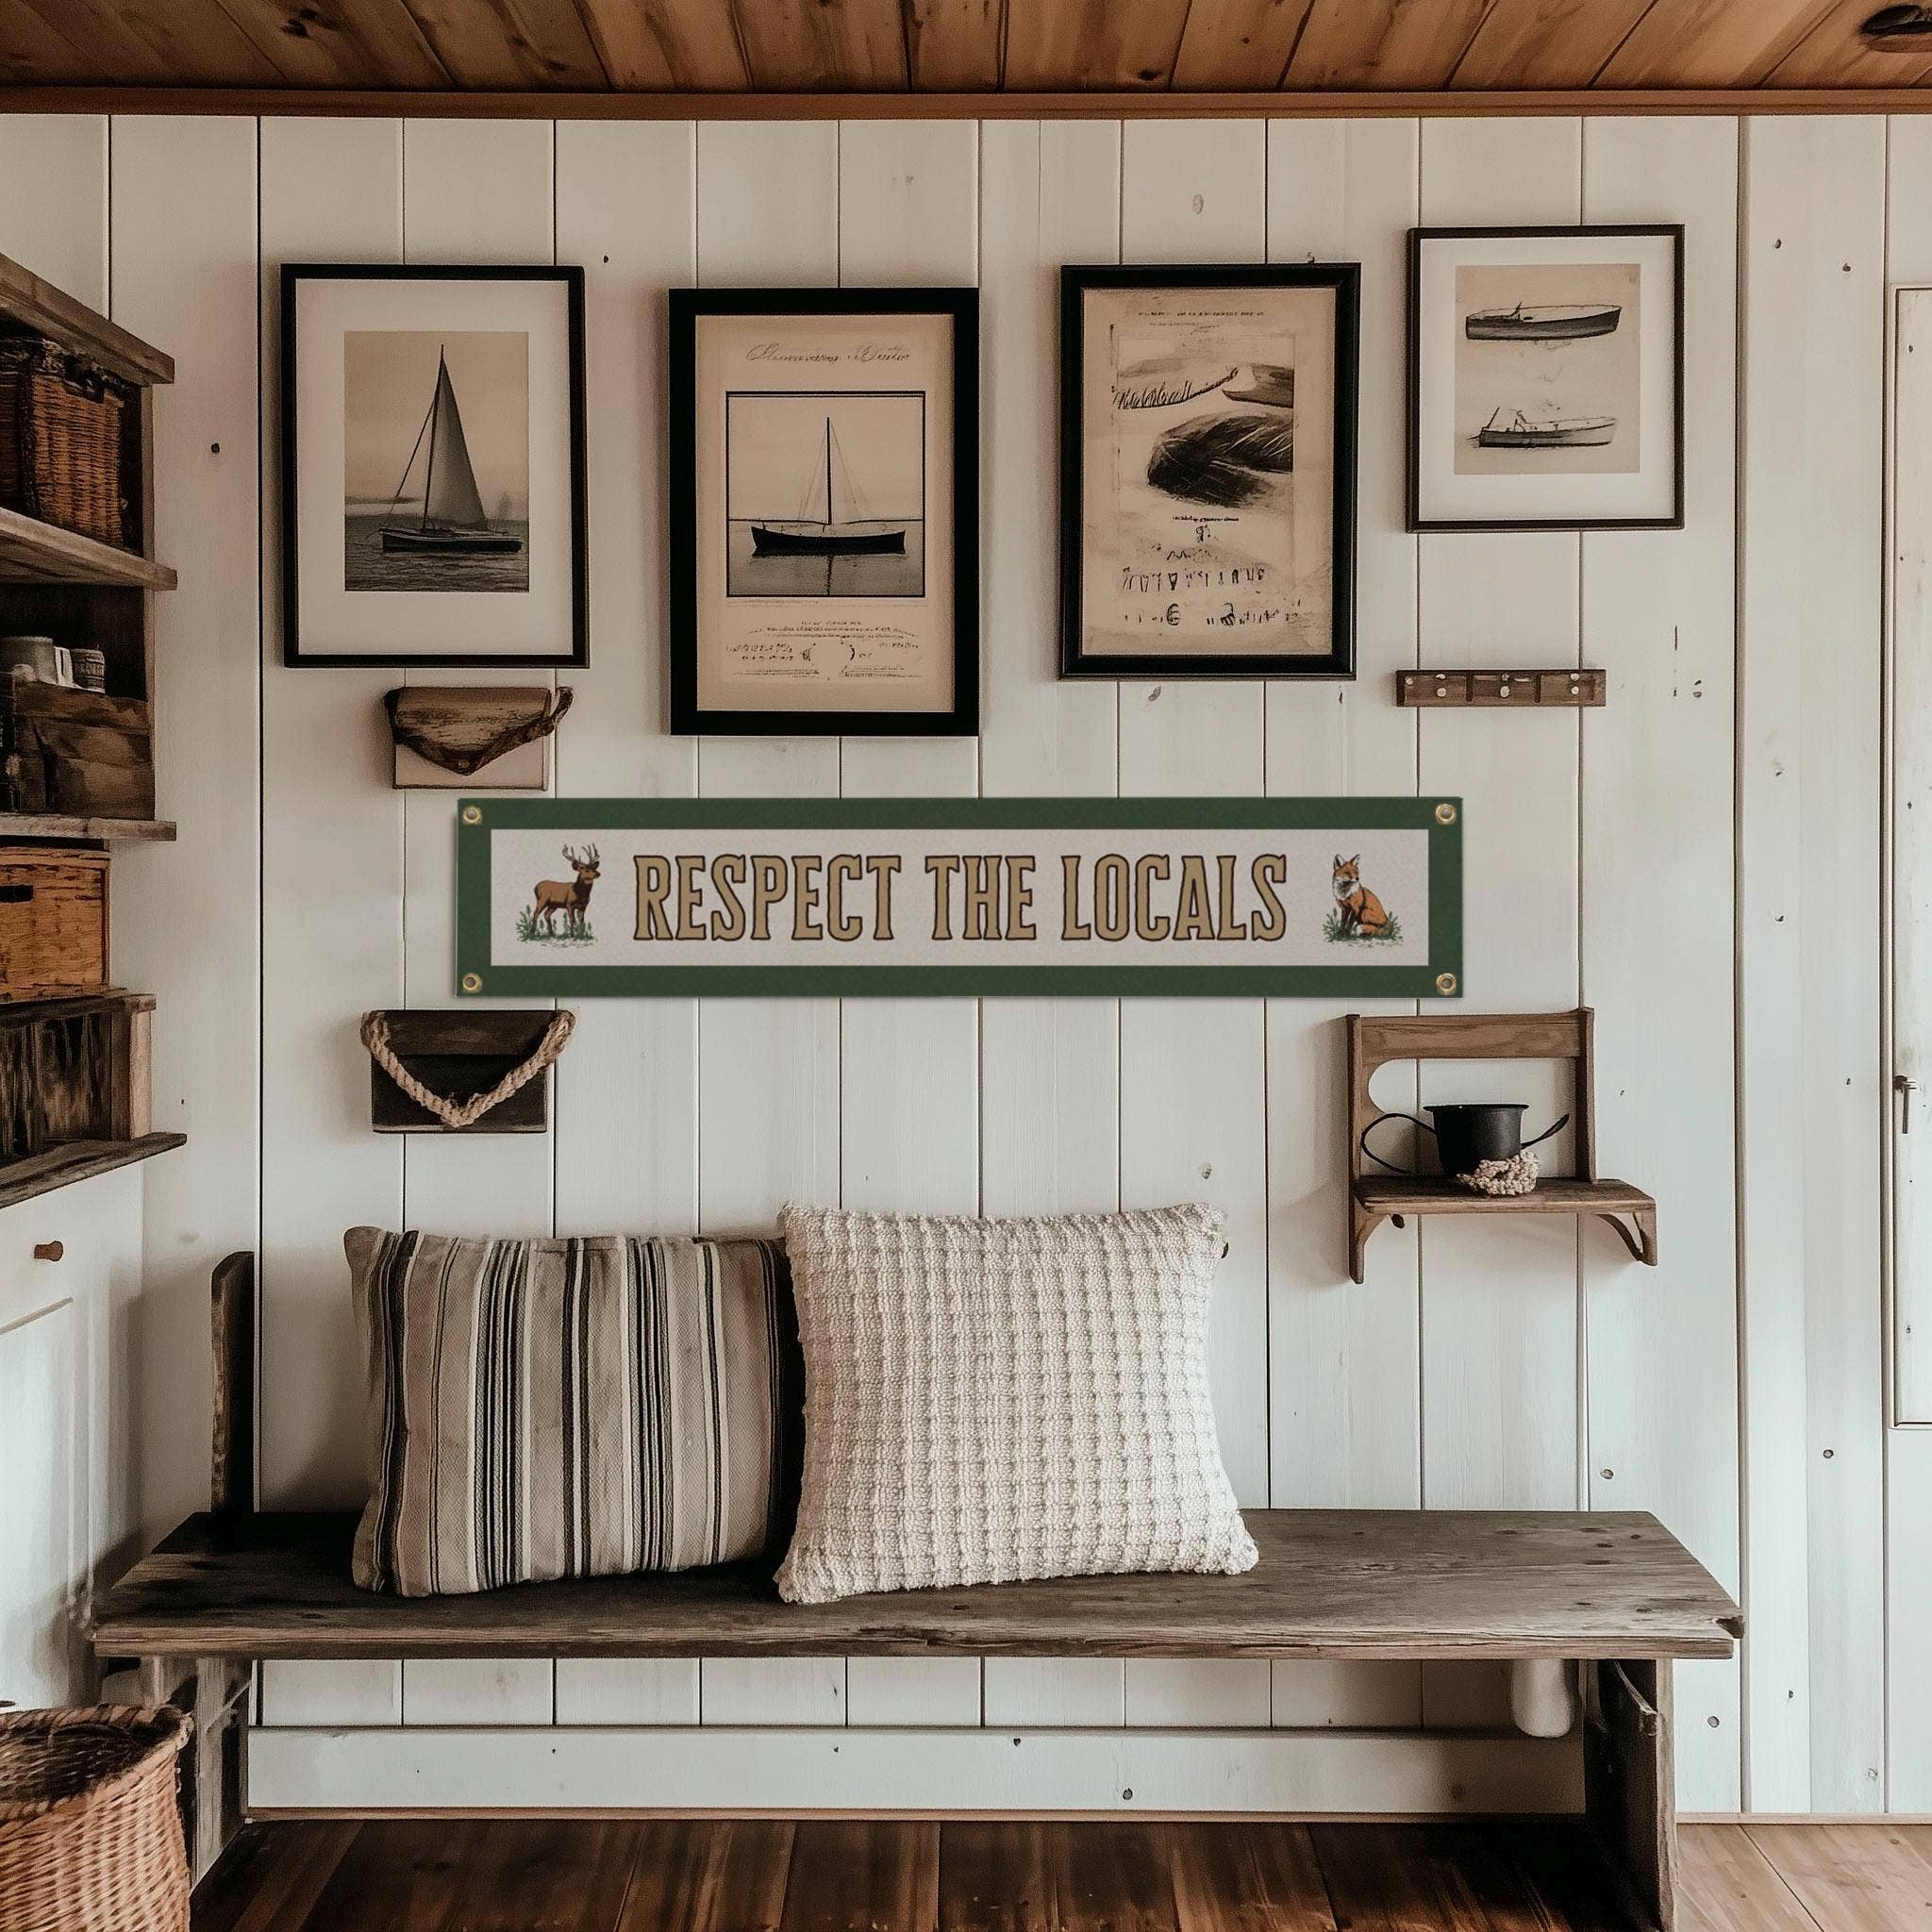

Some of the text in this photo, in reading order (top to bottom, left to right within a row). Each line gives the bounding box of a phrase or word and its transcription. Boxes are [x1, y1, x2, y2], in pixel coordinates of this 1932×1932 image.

[634, 853, 1287, 942] RESPECT THE LOCALS
